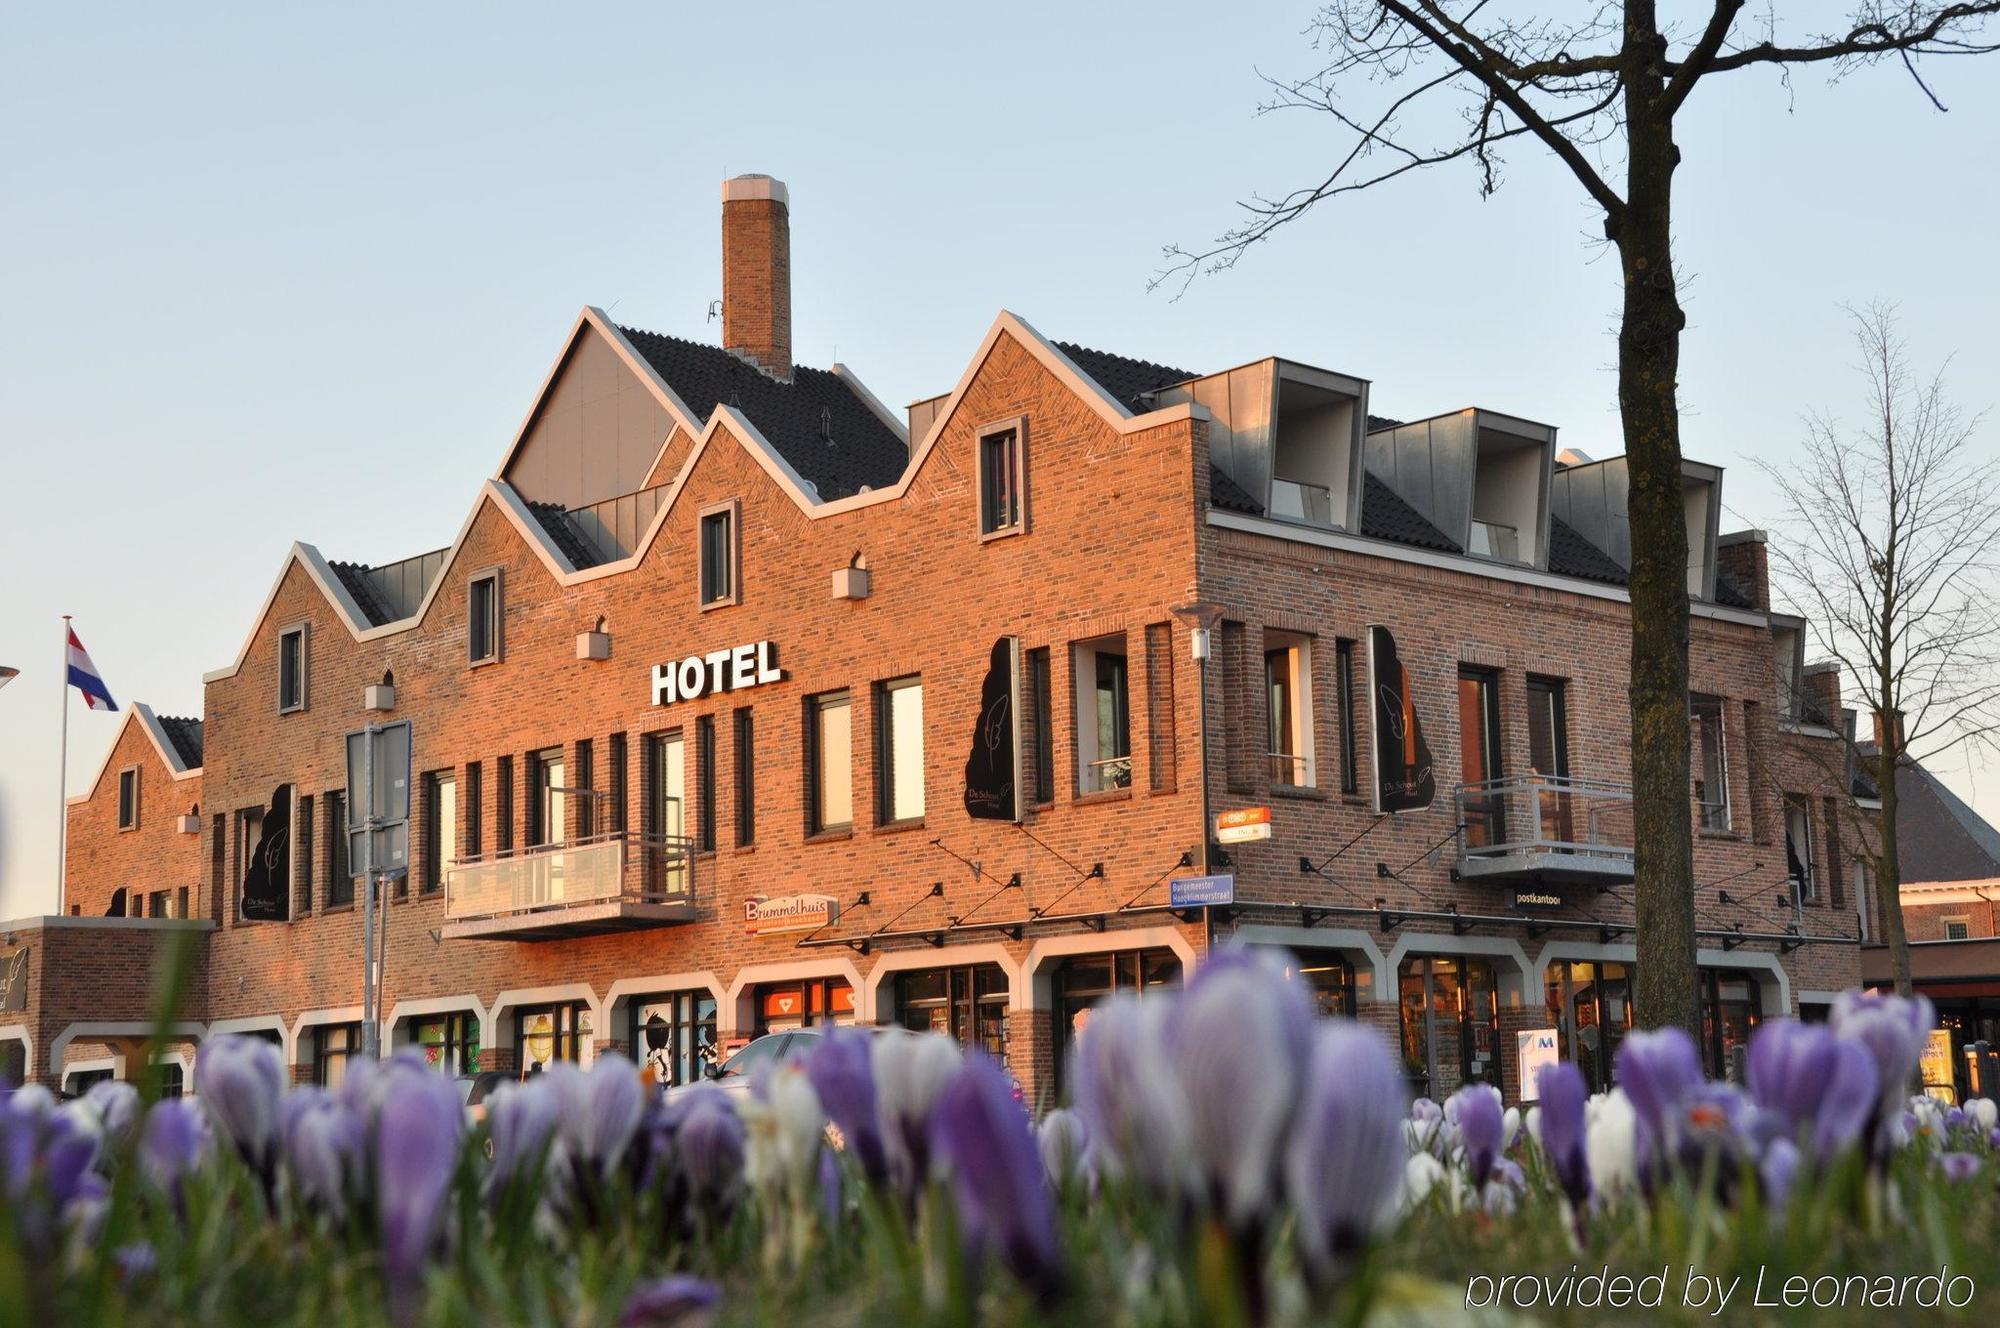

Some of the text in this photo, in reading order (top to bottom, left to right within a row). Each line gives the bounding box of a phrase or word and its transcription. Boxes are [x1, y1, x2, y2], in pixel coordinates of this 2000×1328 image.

[651, 640, 781, 706] HOTEL
[1172, 881, 1215, 893] Burgemeester
[744, 899, 826, 920] Brummelhuis
